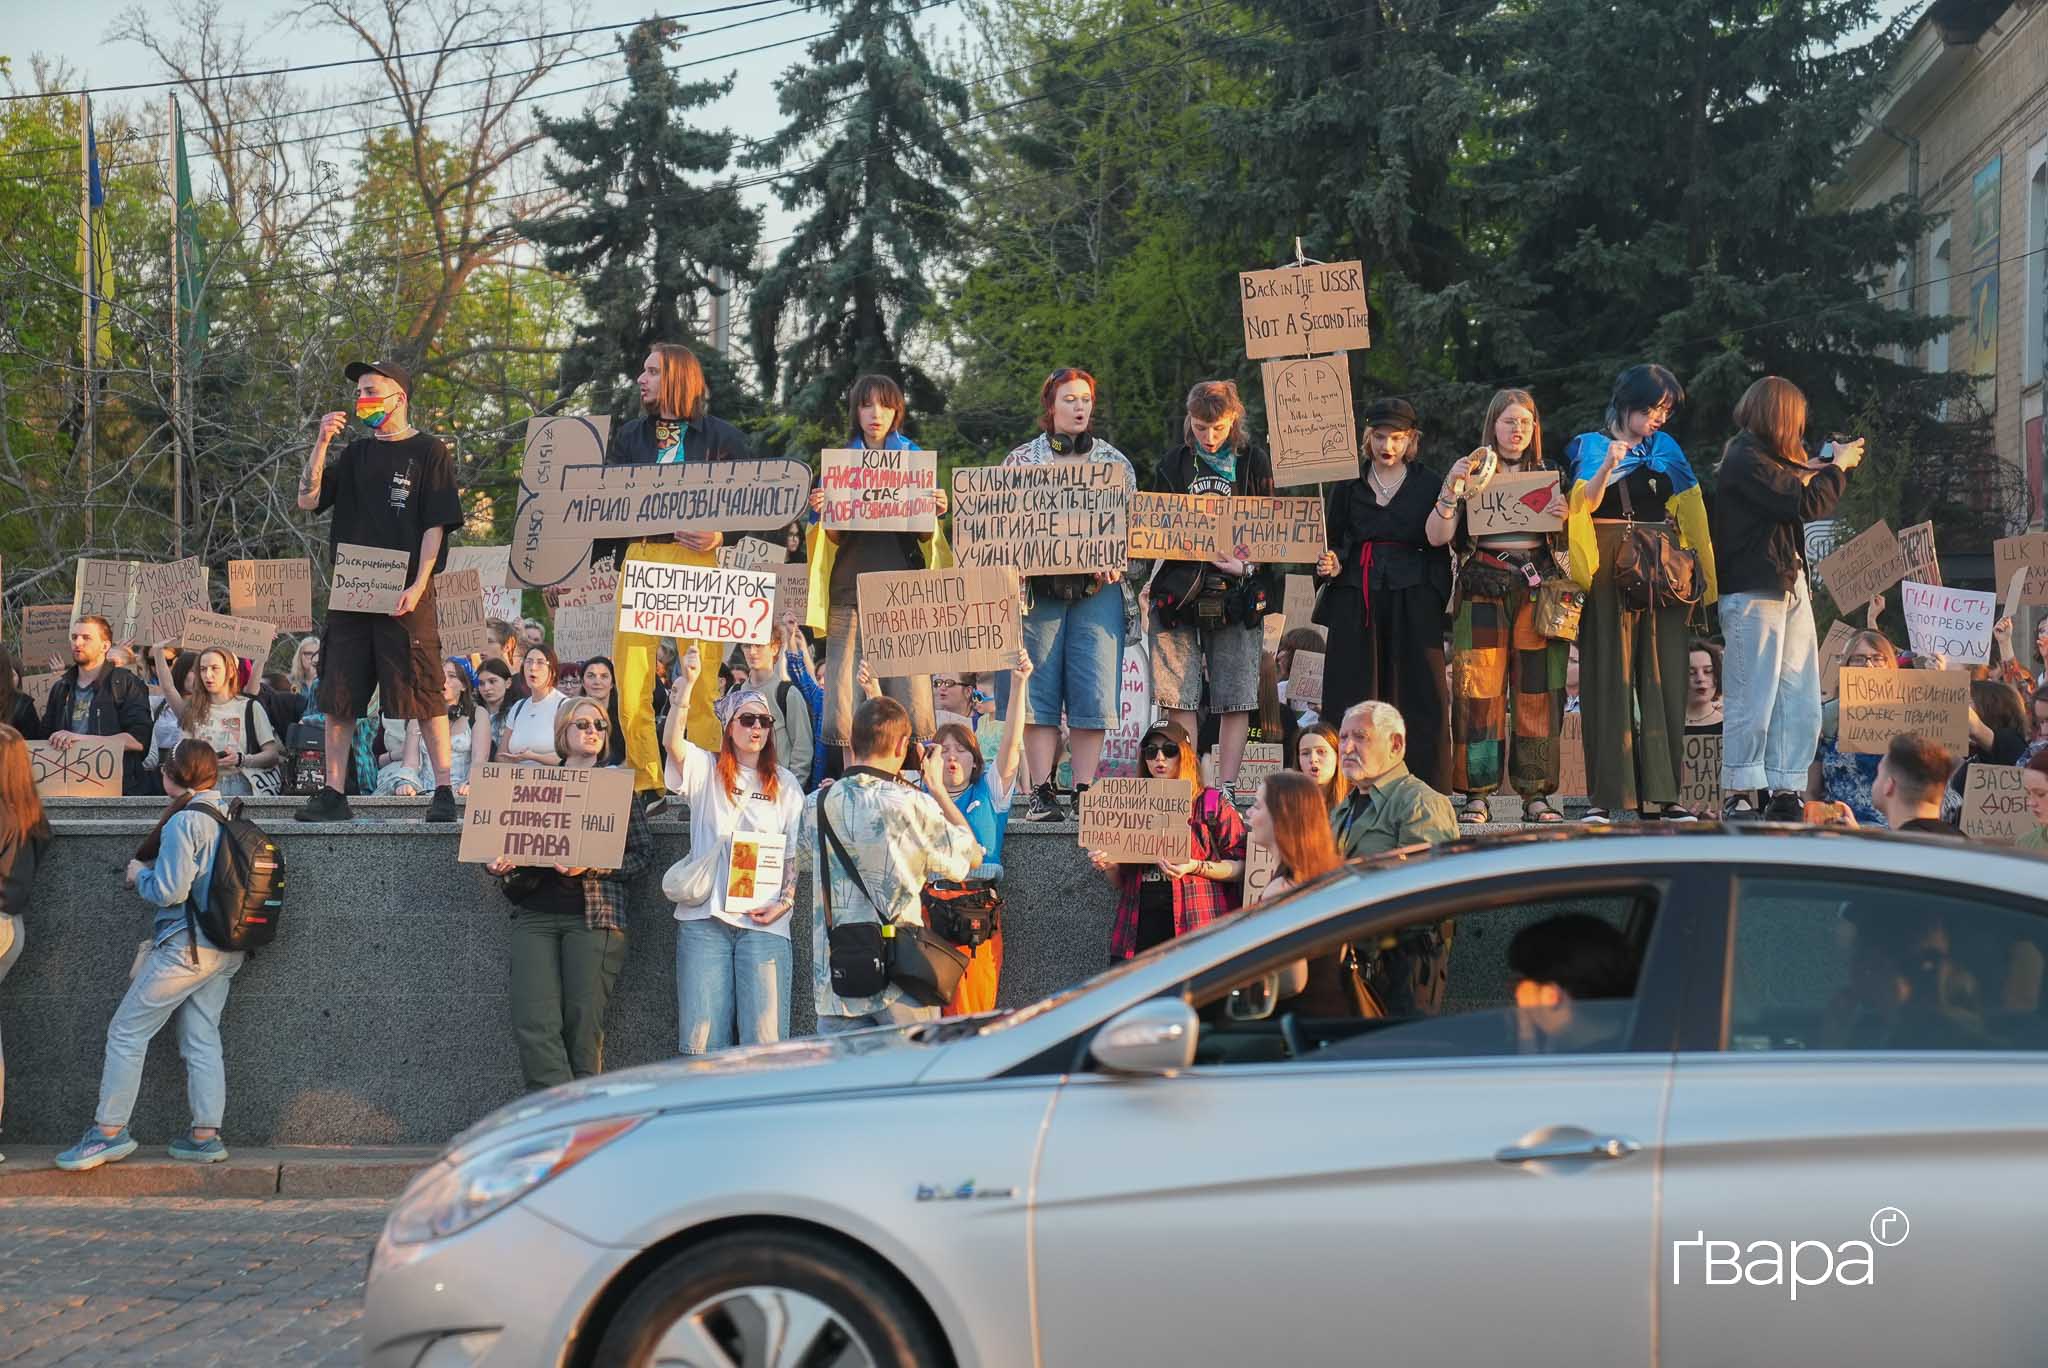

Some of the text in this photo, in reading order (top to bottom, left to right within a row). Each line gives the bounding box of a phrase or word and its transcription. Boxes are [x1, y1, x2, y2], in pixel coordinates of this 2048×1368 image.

[1320, 269, 1360, 292] USSR
[1286, 313, 1297, 335] A
[862, 450, 901, 469] КОЛИ
[1023, 465, 1068, 489] МОЖНА
[1073, 463, 1113, 487] ЦЮ
[862, 487, 901, 502] СТАЄ
[1132, 494, 1188, 513] ВЛАДА
[1481, 491, 1506, 513] ЦК
[964, 518, 986, 545] ЧИ
[990, 512, 1058, 540] ПРИЙДЕ
[1131, 512, 1146, 529] ЯК
[1013, 540, 1072, 570] КОЛИСЬ
[1252, 544, 1287, 558] 15150
[2003, 543, 2031, 561] ЦК
[230, 563, 309, 581] НАМ ПОТРІБЕН
[625, 564, 723, 593] НАСТУПНИЙ
[244, 582, 285, 598] ЗАХИСТ
[885, 576, 965, 607] ЖОДНОГО
[267, 598, 295, 614] А НЕ
[911, 608, 928, 629] НА
[1917, 613, 1985, 631] ПОТРЕБУЄ
[866, 624, 1004, 661] ДЛЯ КОРУПЦІОНЕРІВ
[482, 766, 590, 783] ВИ НЕ ПИШЕТЕ
[1974, 768, 2022, 791] ЗАСУ
[512, 785, 563, 804] ЗАКОН
[1103, 778, 1148, 795] НОВИЙ
[1083, 794, 1190, 815] ЦИВІЛЬНИЙ КОДЕКС
[473, 810, 491, 825] ВИ
[499, 810, 573, 830] СТИРАЄТЕ
[1083, 810, 1154, 830] ПОРУШУЄ
[503, 832, 570, 857] ПРАВА
[1082, 830, 1188, 857] ПРАВА ЛЮДИНИ
